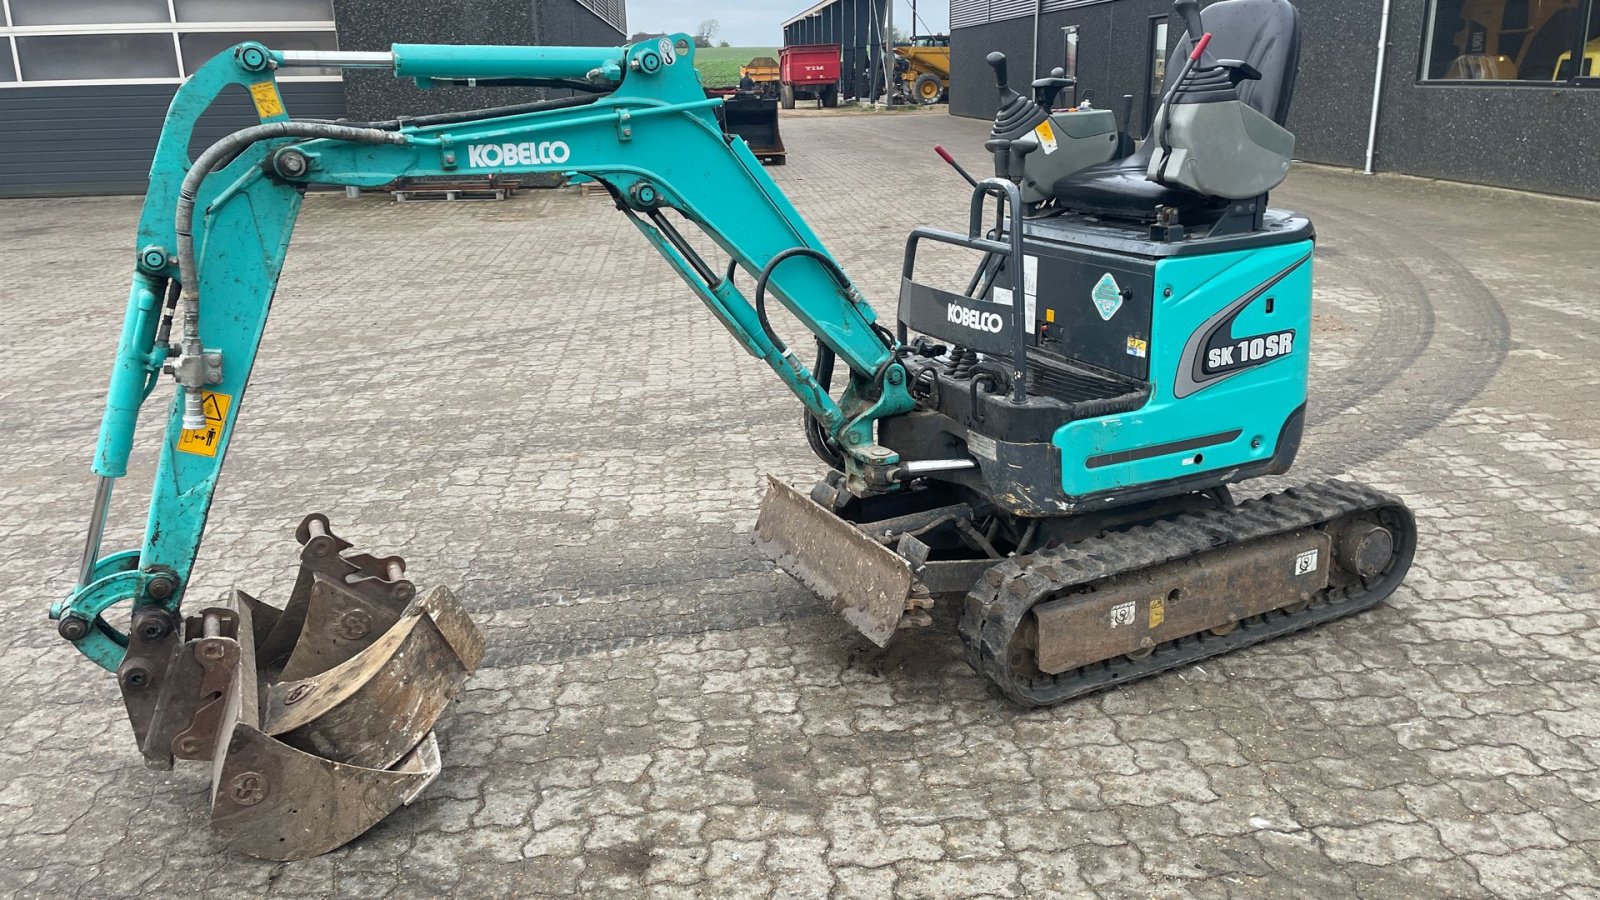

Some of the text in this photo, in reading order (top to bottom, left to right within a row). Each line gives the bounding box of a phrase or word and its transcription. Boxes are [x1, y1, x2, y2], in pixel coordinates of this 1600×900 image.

[467, 140, 571, 168] KOBELCO
[947, 302, 1003, 334] KOBELCO
[1208, 332, 1293, 368] SK 10SR
